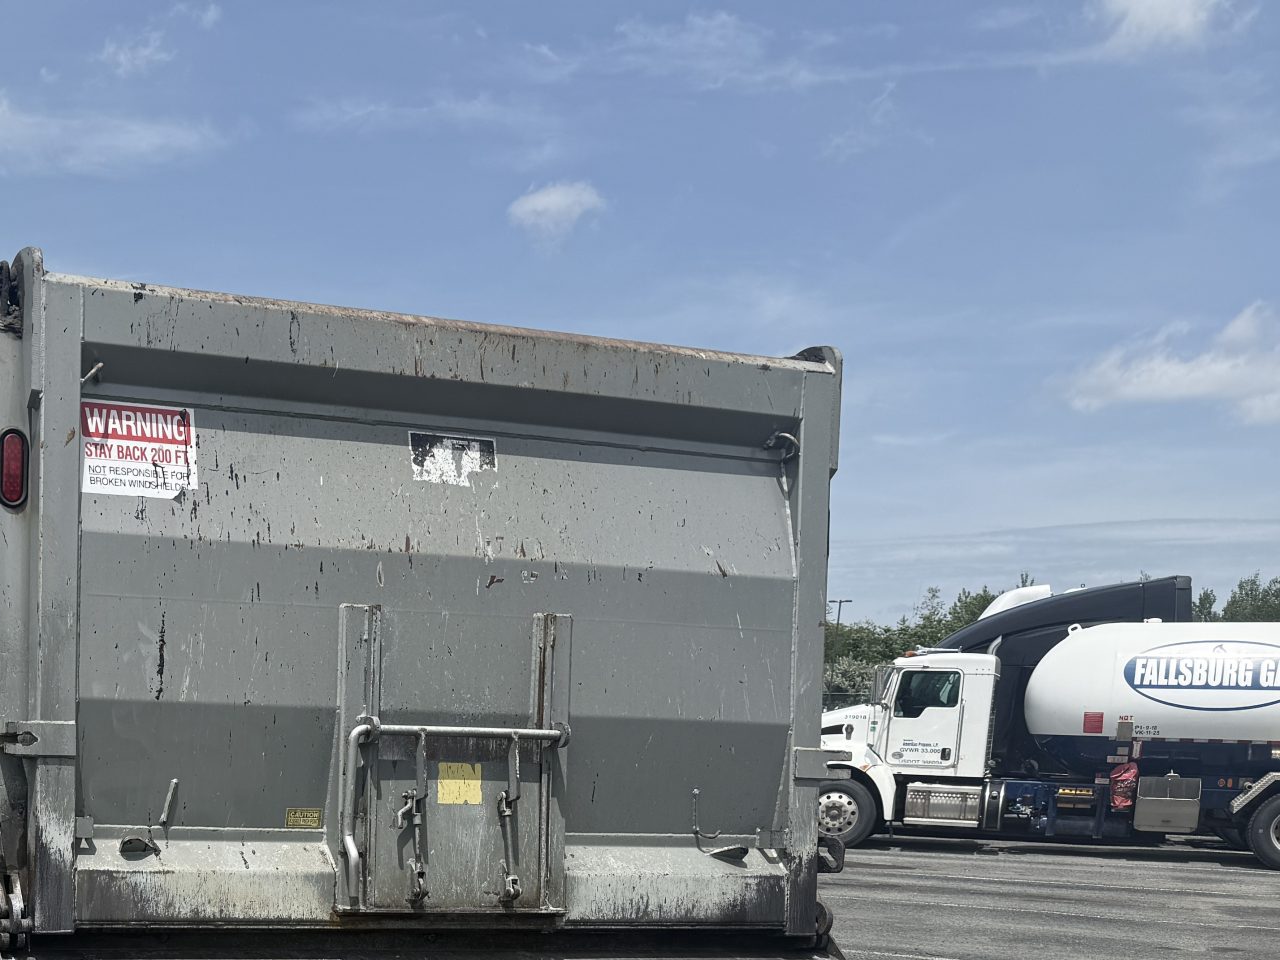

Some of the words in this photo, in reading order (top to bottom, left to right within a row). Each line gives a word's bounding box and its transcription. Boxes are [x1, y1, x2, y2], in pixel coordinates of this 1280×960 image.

[84, 407, 187, 441] WARNING
[85, 441, 114, 459] STAY
[117, 445, 148, 462] BACK
[151, 448, 172, 464] 200
[175, 450, 189, 465] FT
[88, 465, 107, 474] NOT
[109, 466, 169, 480] RESPONSIBLE
[171, 471, 191, 481] FOR
[90, 476, 126, 487] BROKEN
[1133, 657, 1254, 688] FALLSBURG
[290, 811, 319, 819] CAUTION
